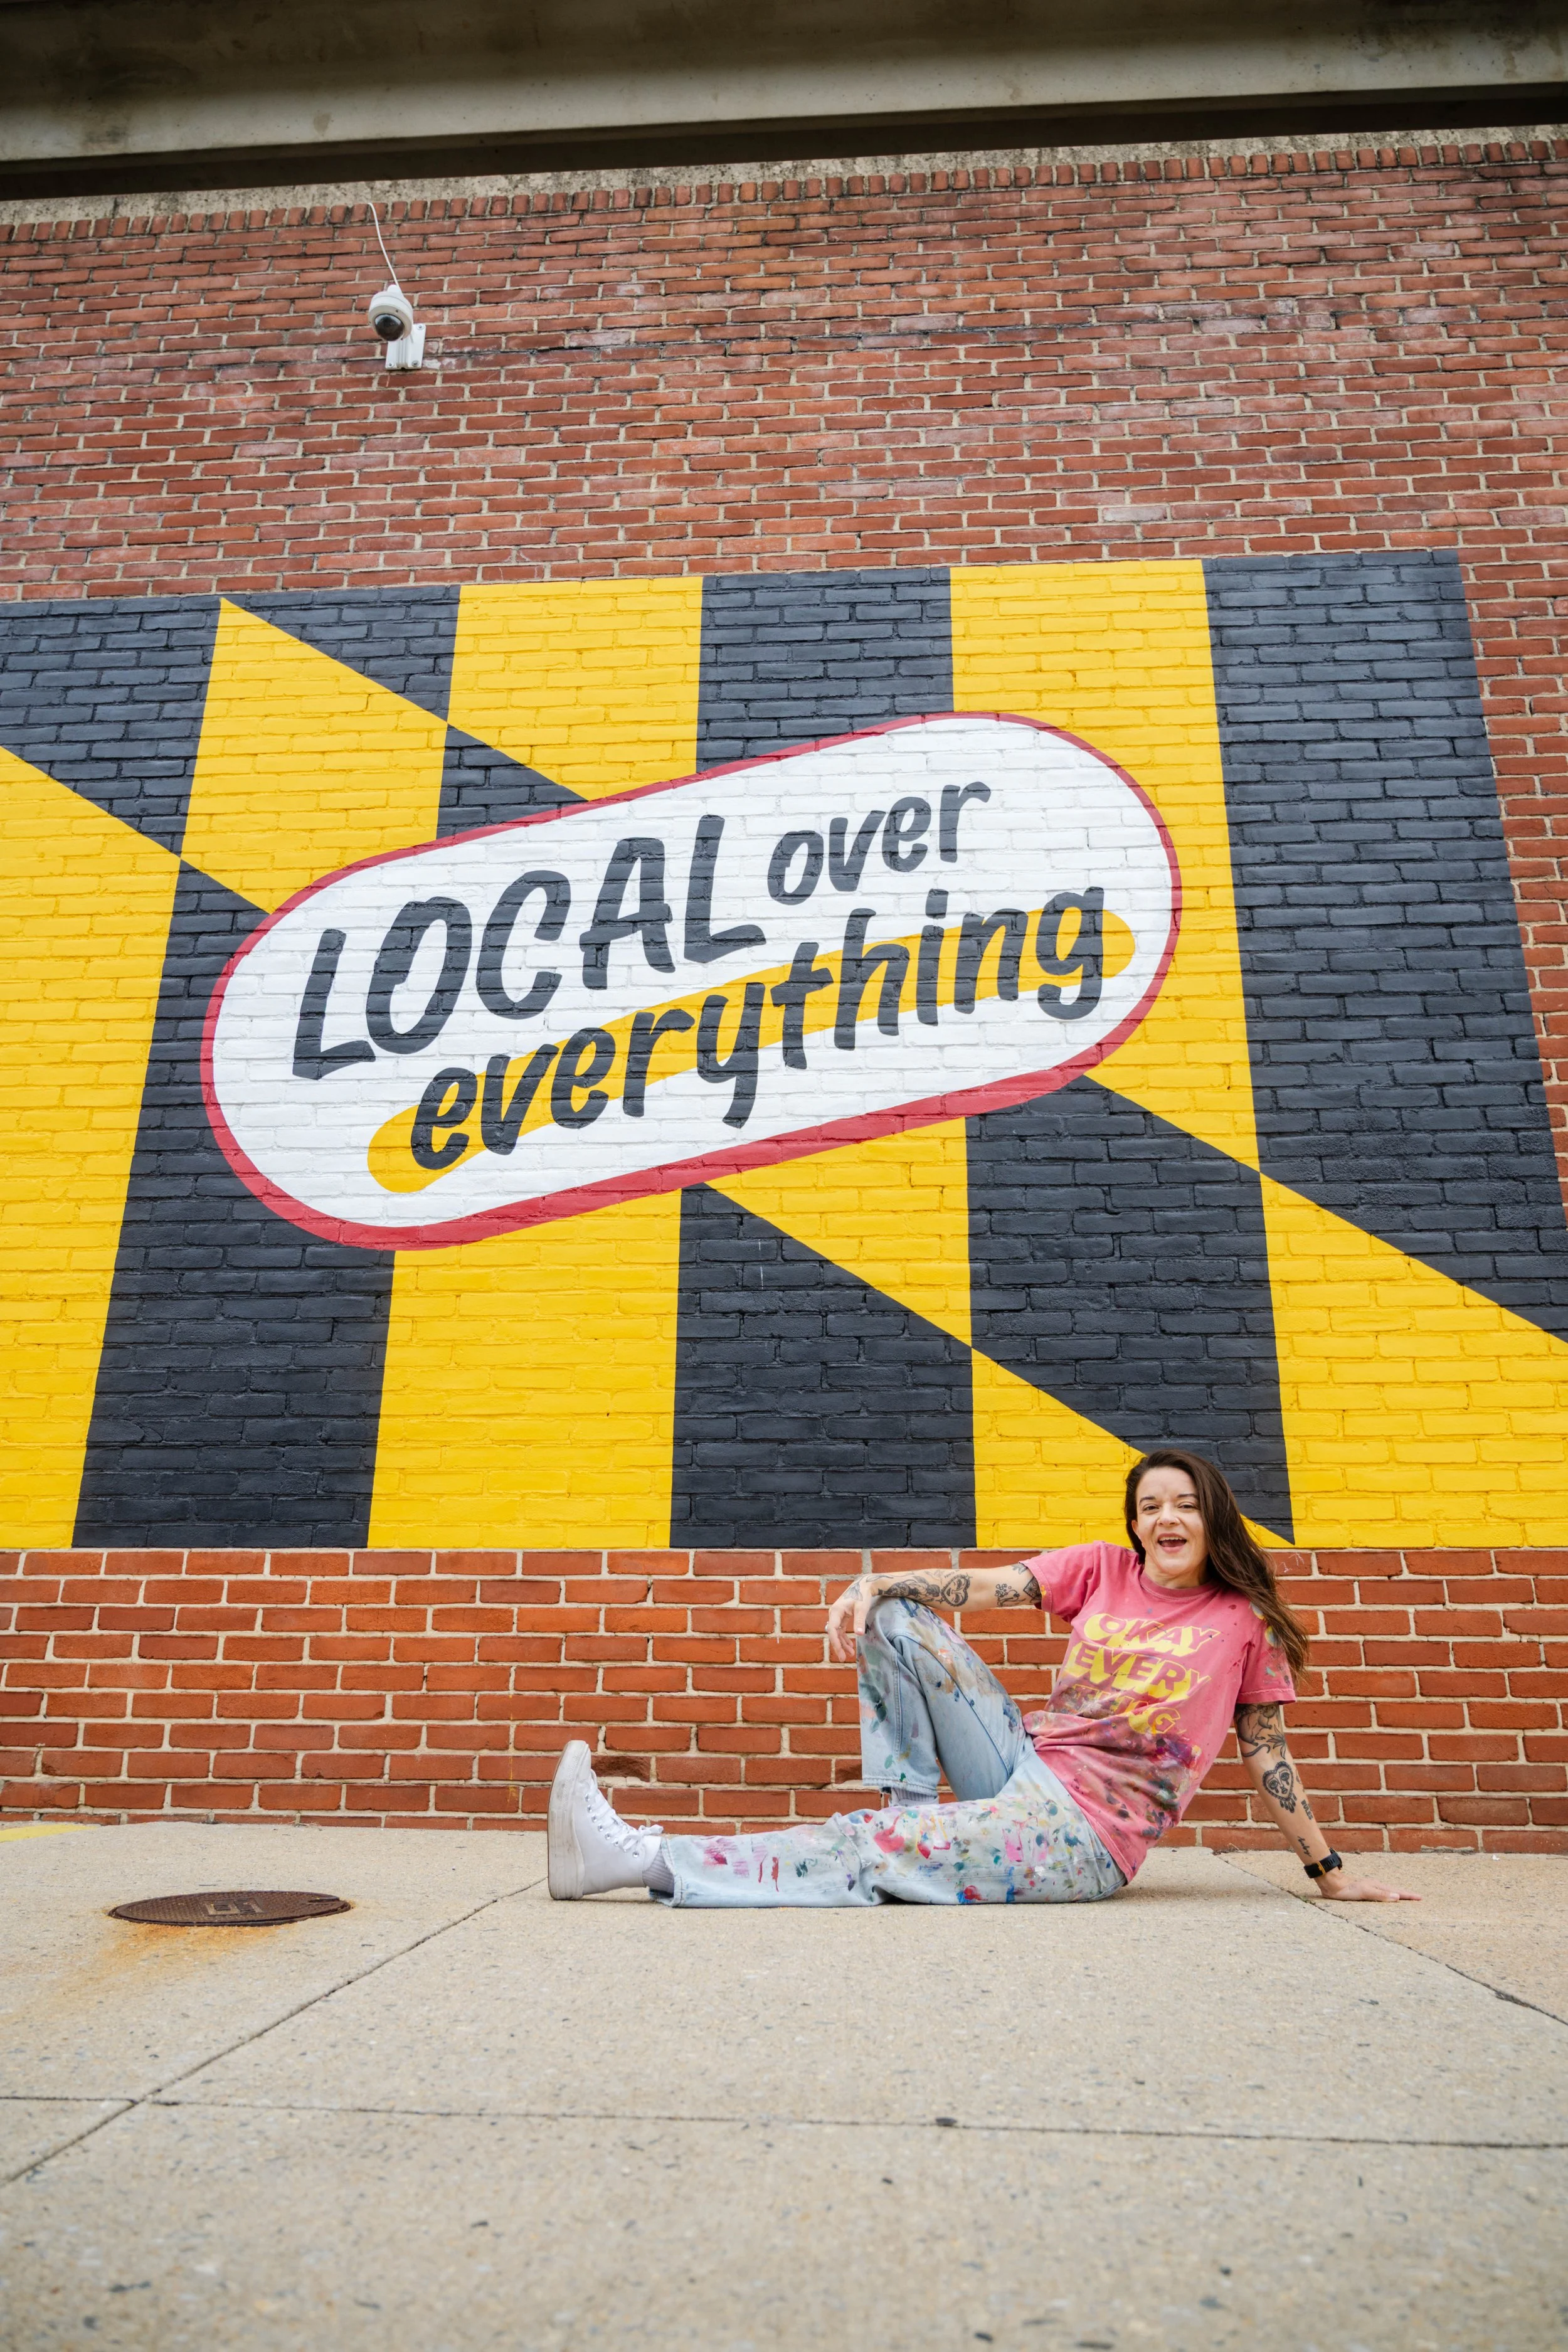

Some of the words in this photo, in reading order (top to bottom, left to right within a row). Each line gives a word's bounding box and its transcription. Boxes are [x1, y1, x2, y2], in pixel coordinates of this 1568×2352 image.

[293, 813, 766, 1080] LOCAL
[767, 780, 991, 905] over
[411, 886, 1104, 1170] everything
[1064, 1641, 1212, 1702] EVERY
[1084, 1613, 1221, 1657] OKAY
